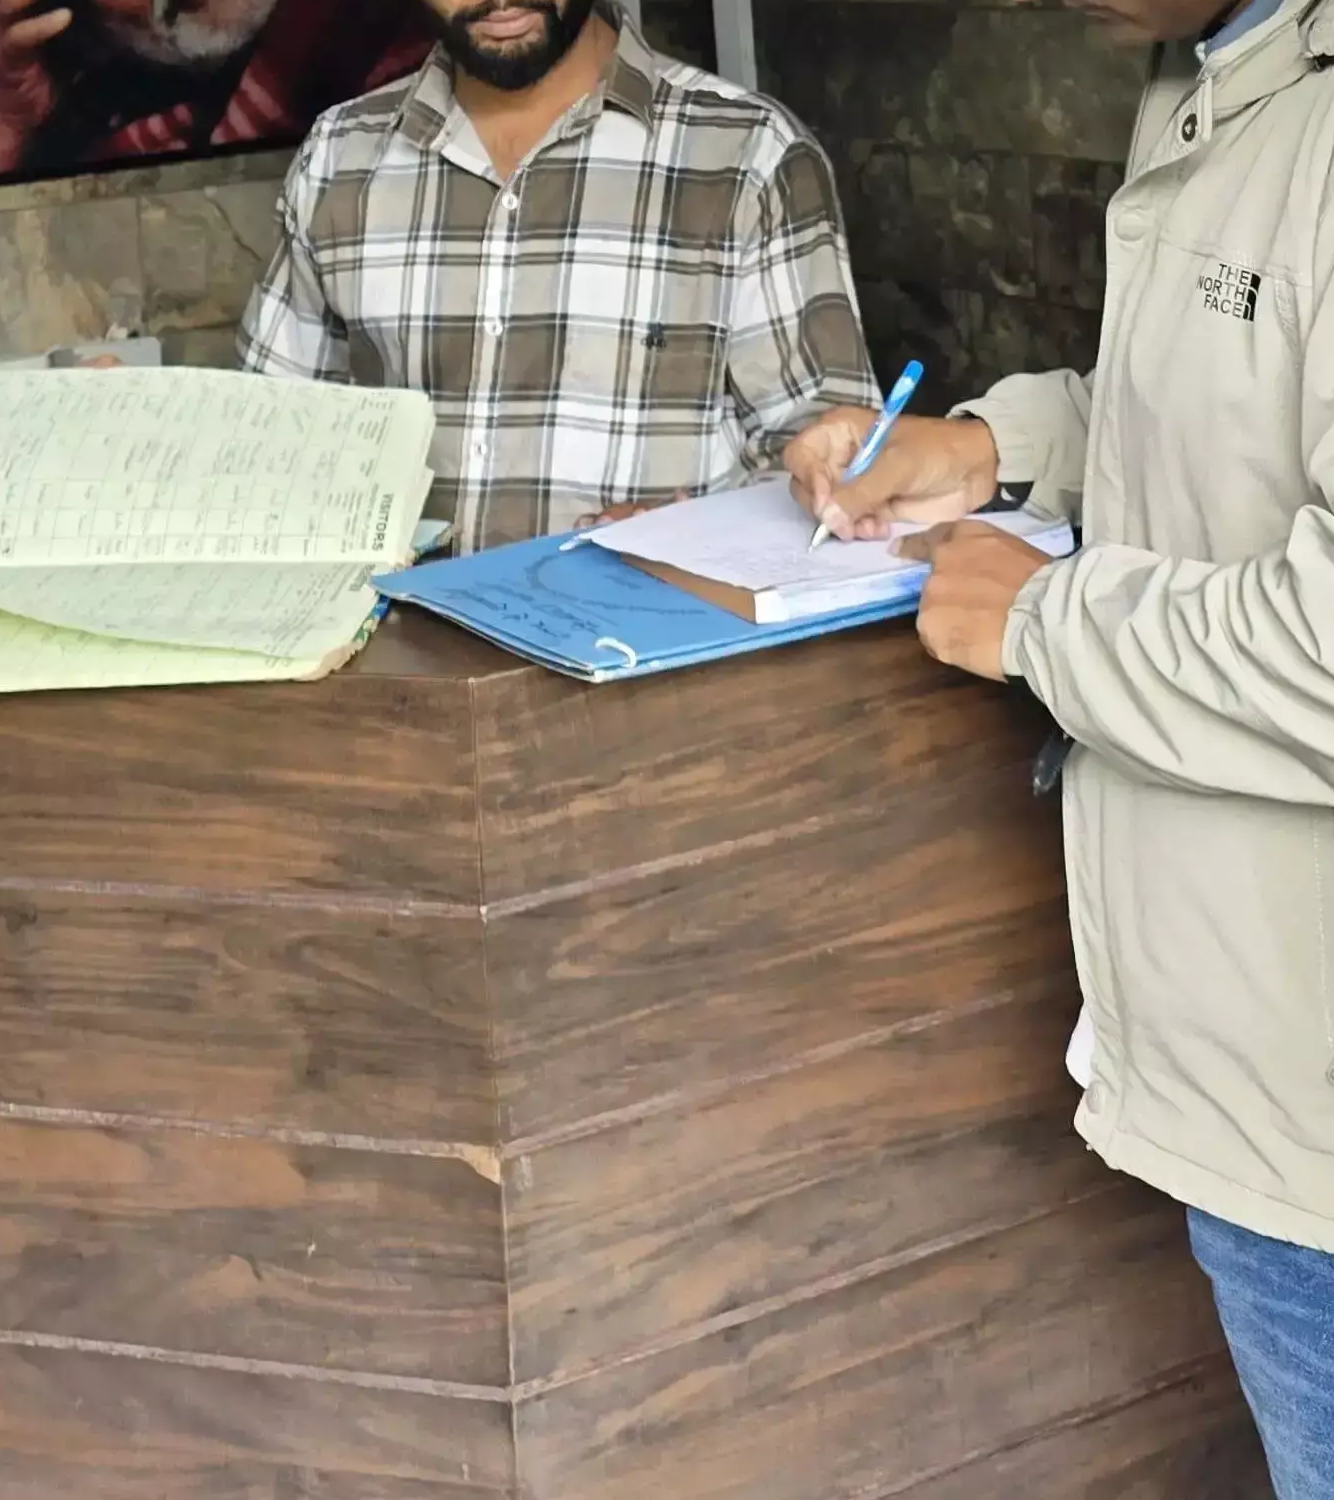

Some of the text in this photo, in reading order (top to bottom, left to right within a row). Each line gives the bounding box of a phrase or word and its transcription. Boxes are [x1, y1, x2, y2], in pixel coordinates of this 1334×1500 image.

[1218, 263, 1251, 286] THE
[1195, 275, 1247, 302] NORTH
[1203, 293, 1244, 319] FACE
[372, 492, 395, 552] VISITORS
